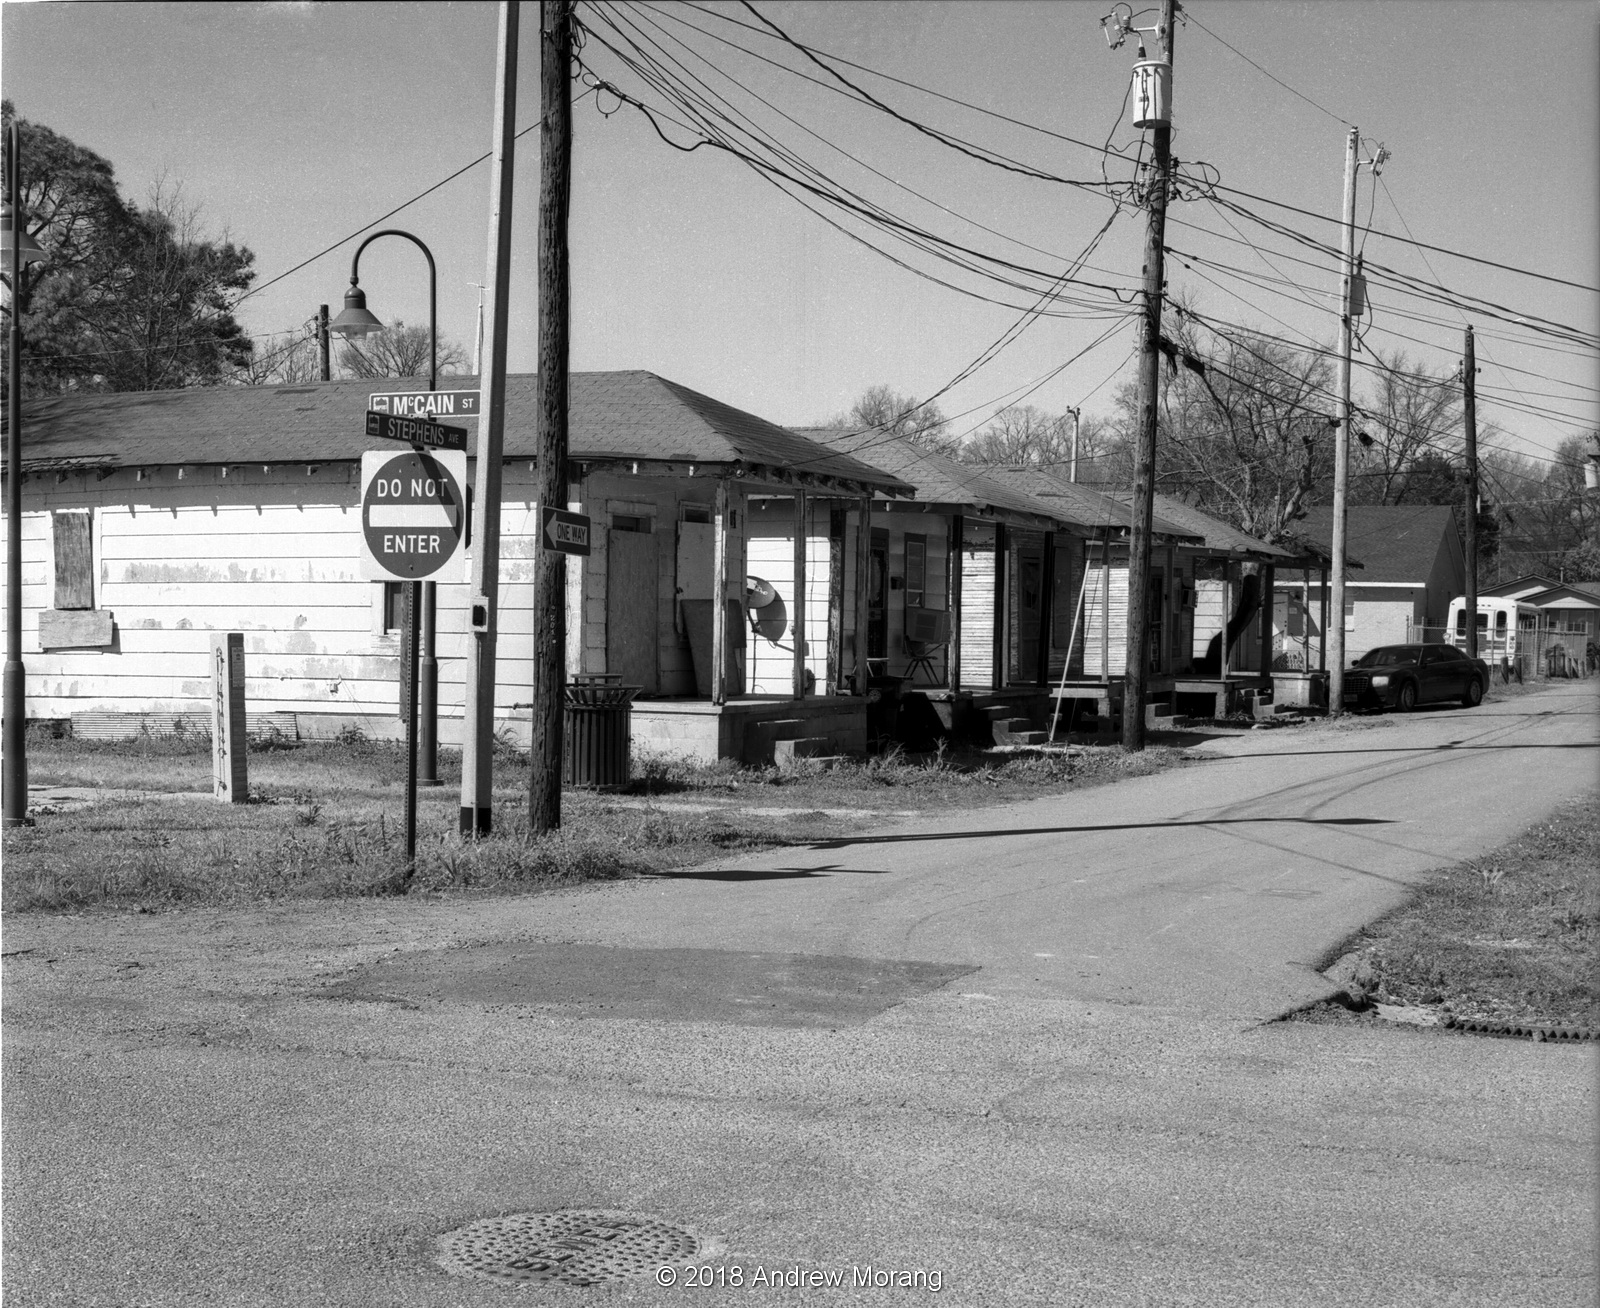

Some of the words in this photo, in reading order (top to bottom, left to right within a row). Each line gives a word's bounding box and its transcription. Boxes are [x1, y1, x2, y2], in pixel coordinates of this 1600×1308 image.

[462, 398, 474, 409] ST
[387, 418, 445, 445] STEPHENS
[448, 433, 459, 444] AVE
[377, 479, 401, 498] DO
[411, 479, 449, 498] NOT
[557, 523, 570, 541] ONE
[571, 526, 586, 544] WAY
[384, 535, 440, 553] ENTER
[505, 1221, 642, 1272] SEWER
